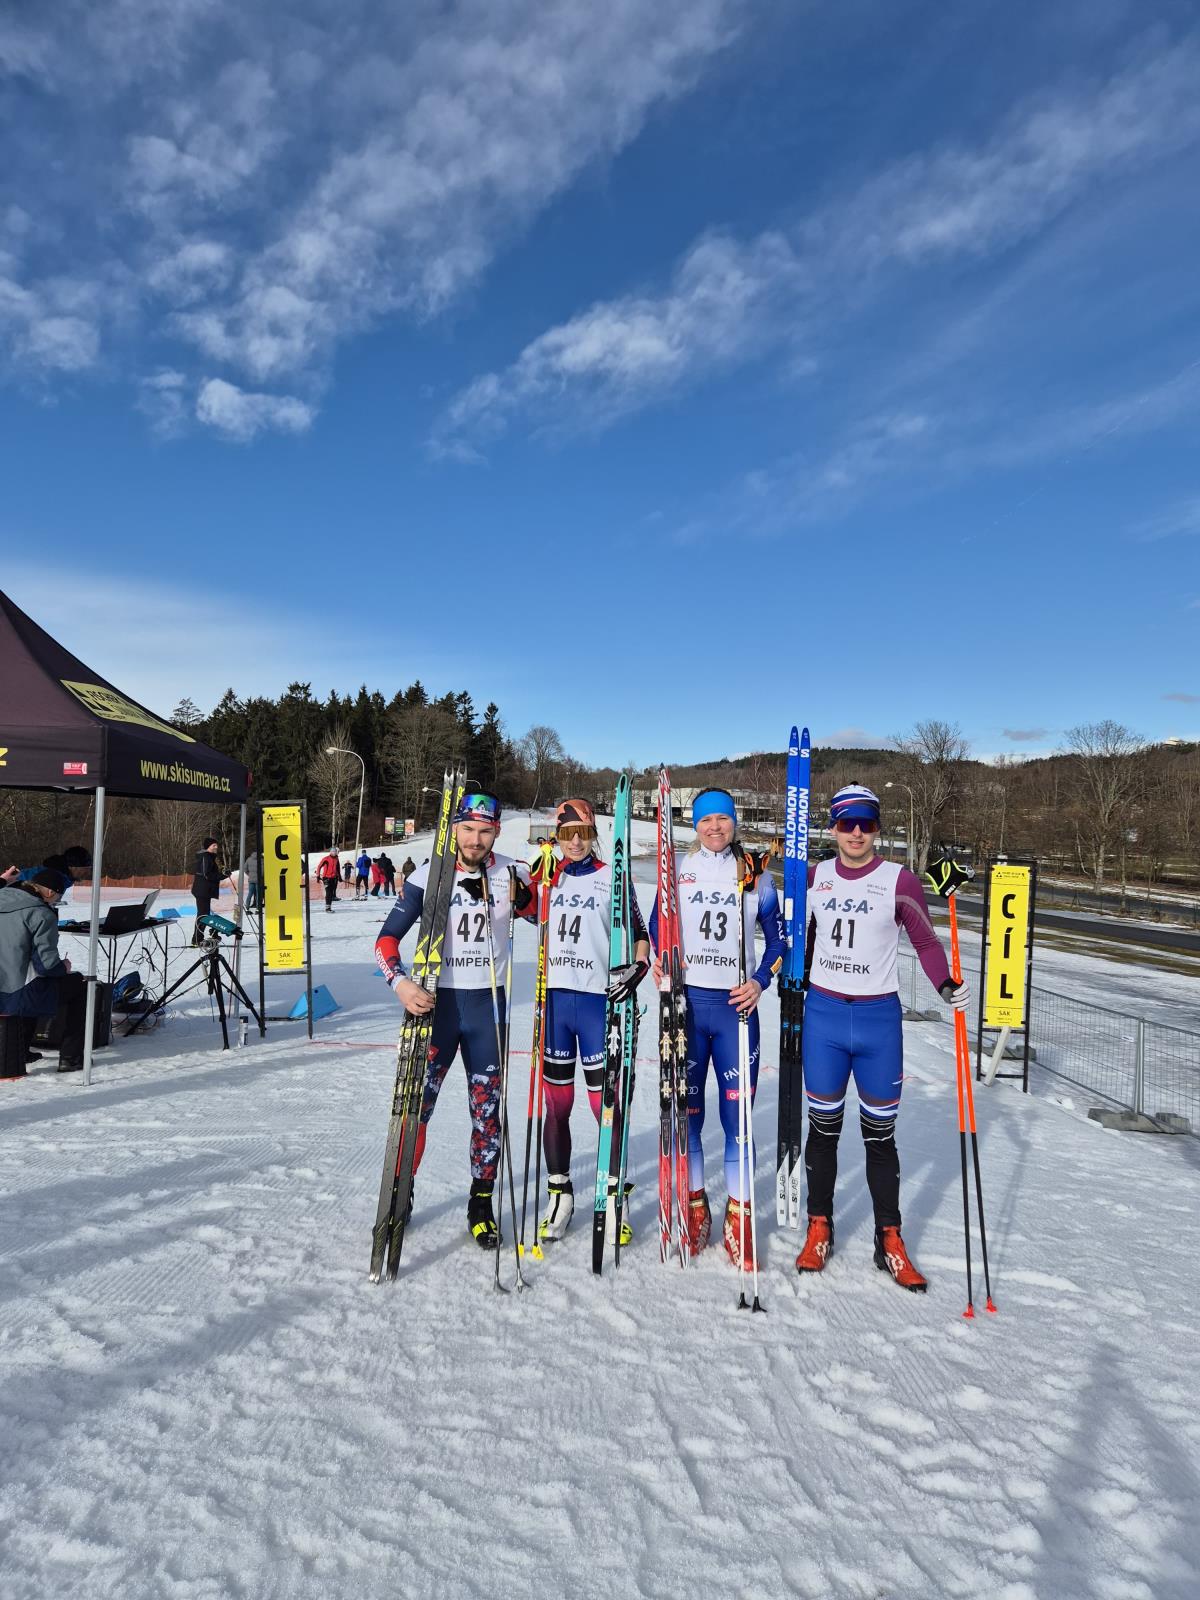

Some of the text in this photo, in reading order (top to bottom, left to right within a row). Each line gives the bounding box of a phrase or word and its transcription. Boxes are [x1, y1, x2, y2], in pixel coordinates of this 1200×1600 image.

[140, 760, 231, 792] www.skisumava.cz
[436, 789, 452, 857] FISCHER
[786, 786, 797, 859] SALOMON
[797, 788, 809, 862] SALOMON
[456, 913, 486, 943] 42
[558, 914, 582, 944] 44
[699, 911, 728, 942] 43
[831, 918, 855, 949] 41
[686, 955, 737, 968] VIMPERK
